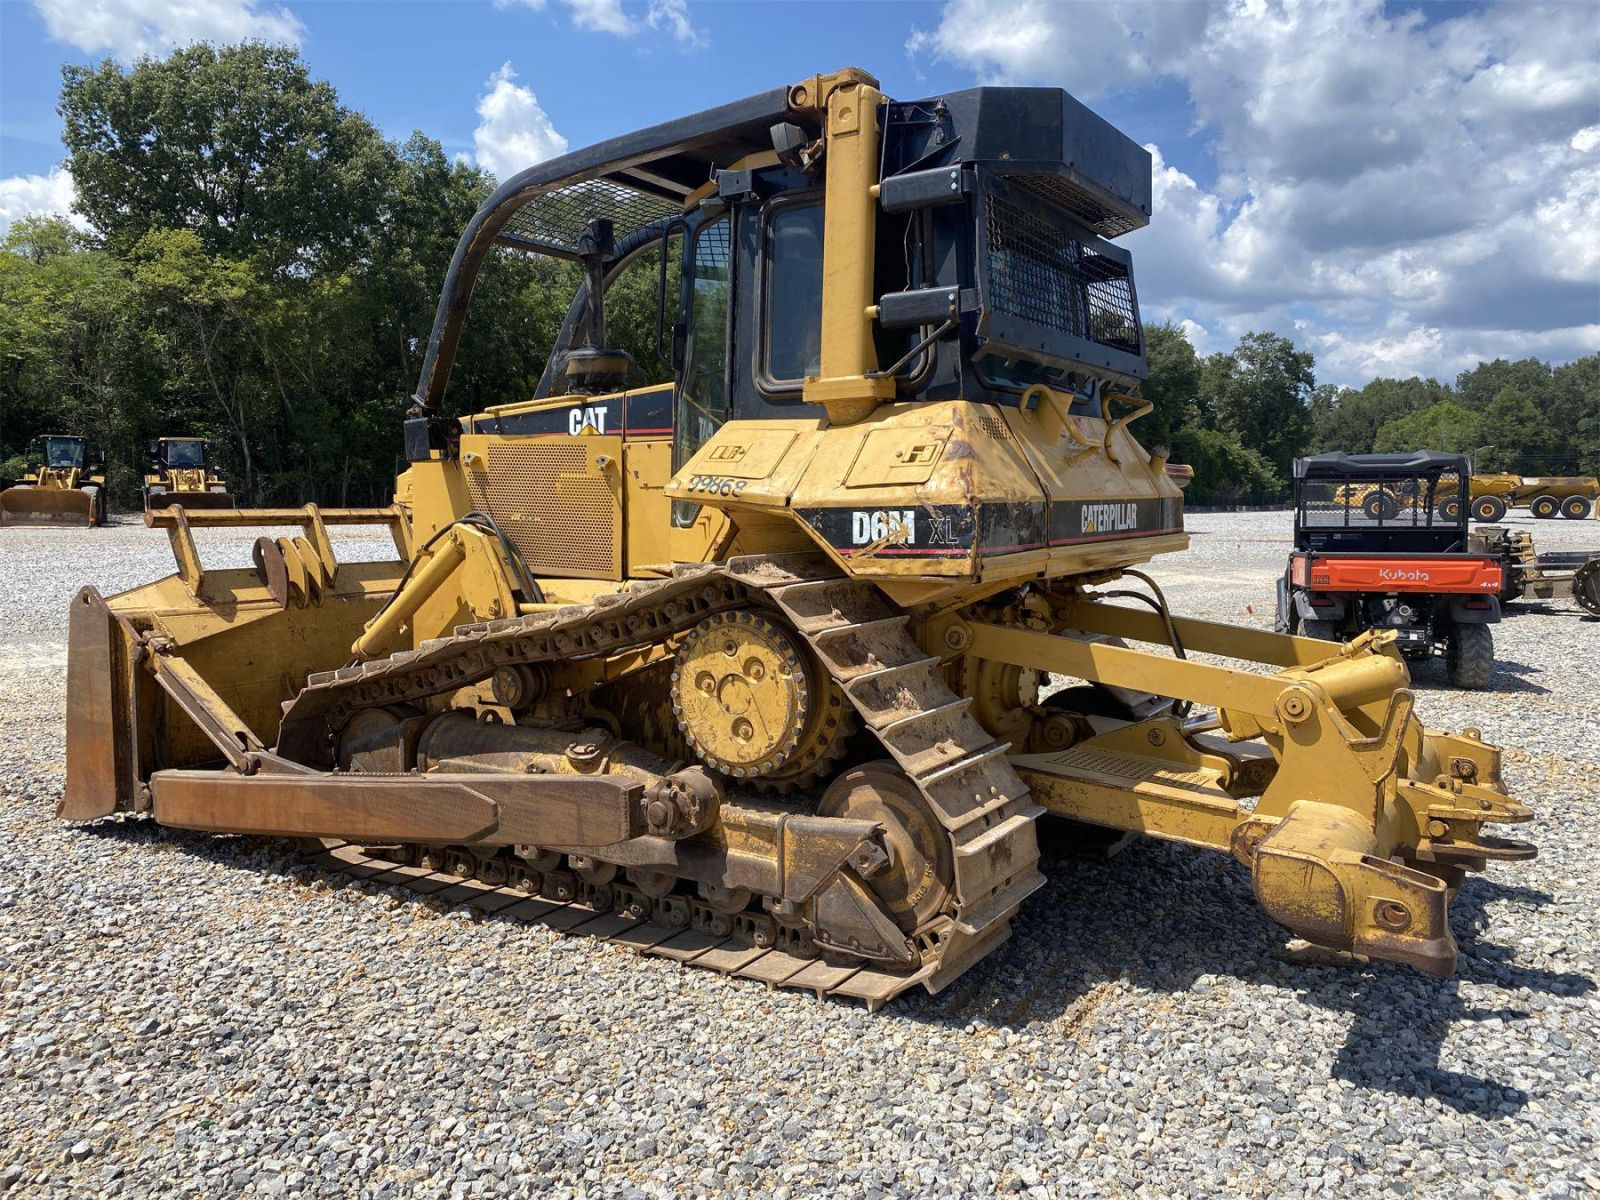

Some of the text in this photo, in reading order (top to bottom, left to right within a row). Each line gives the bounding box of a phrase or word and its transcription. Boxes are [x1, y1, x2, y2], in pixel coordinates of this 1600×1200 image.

[569, 406, 607, 436] CAT
[852, 510, 959, 544] D6M XL
[1081, 503, 1137, 534] CATERPILLAR
[1379, 568, 1430, 581] Kubota
[1479, 581, 1499, 589] 4x4
